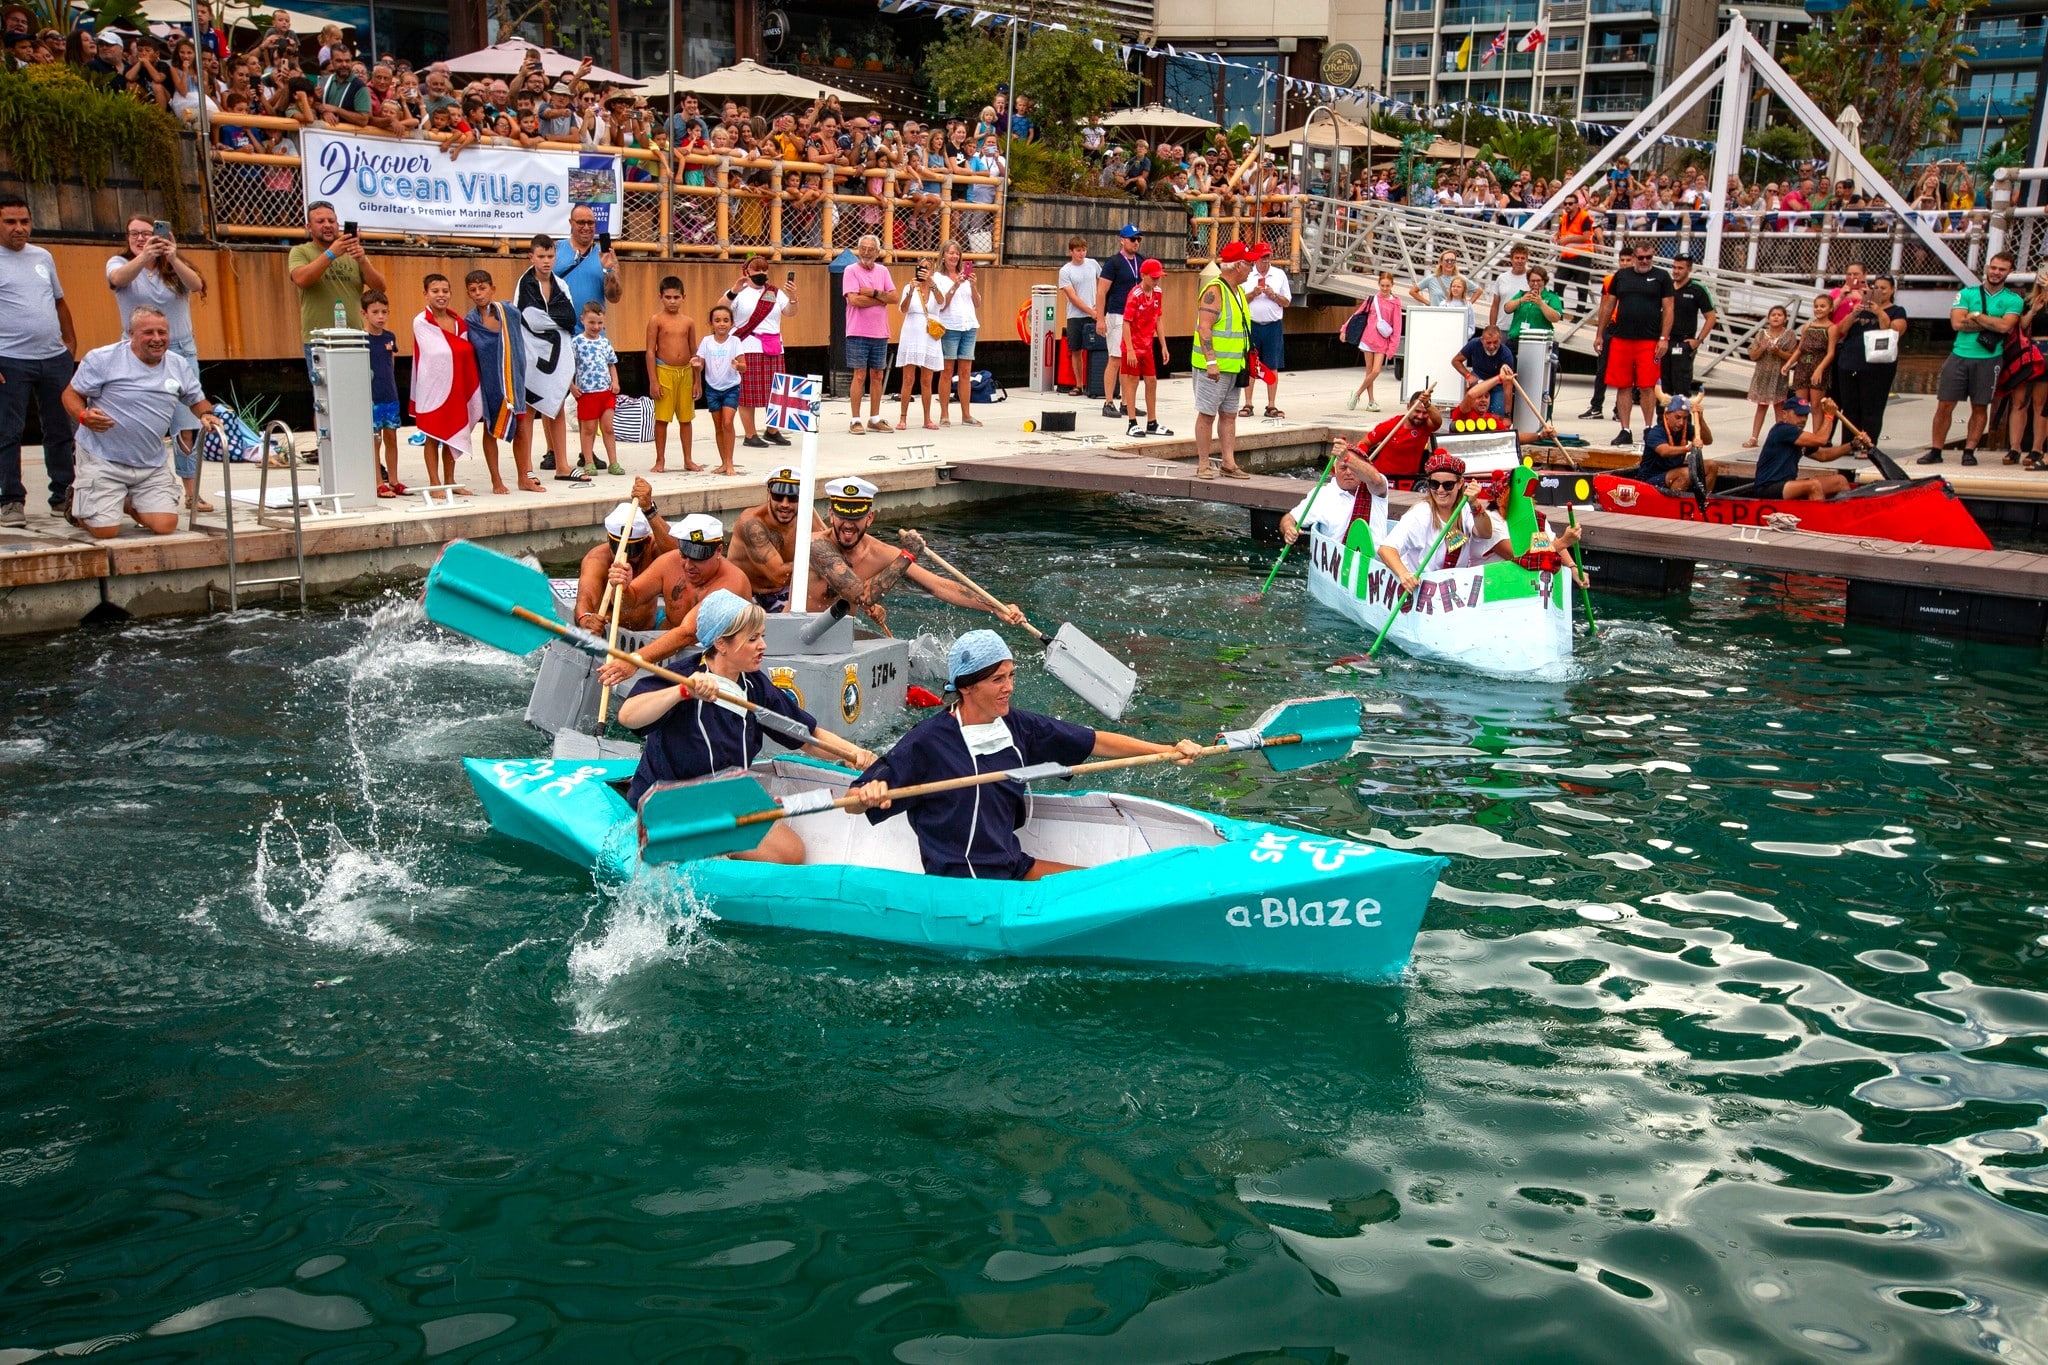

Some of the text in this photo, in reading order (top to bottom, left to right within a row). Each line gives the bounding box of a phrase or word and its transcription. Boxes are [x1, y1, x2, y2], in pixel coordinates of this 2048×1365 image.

[320, 141, 432, 195] Discover
[357, 165, 560, 213] Ocean Village
[359, 202, 524, 219] Gibraltar's Premier Marina Resort
[1540, 477, 1559, 489] Jeep
[1311, 536, 1343, 583] LAN
[1225, 897, 1383, 928] a-Blaze
